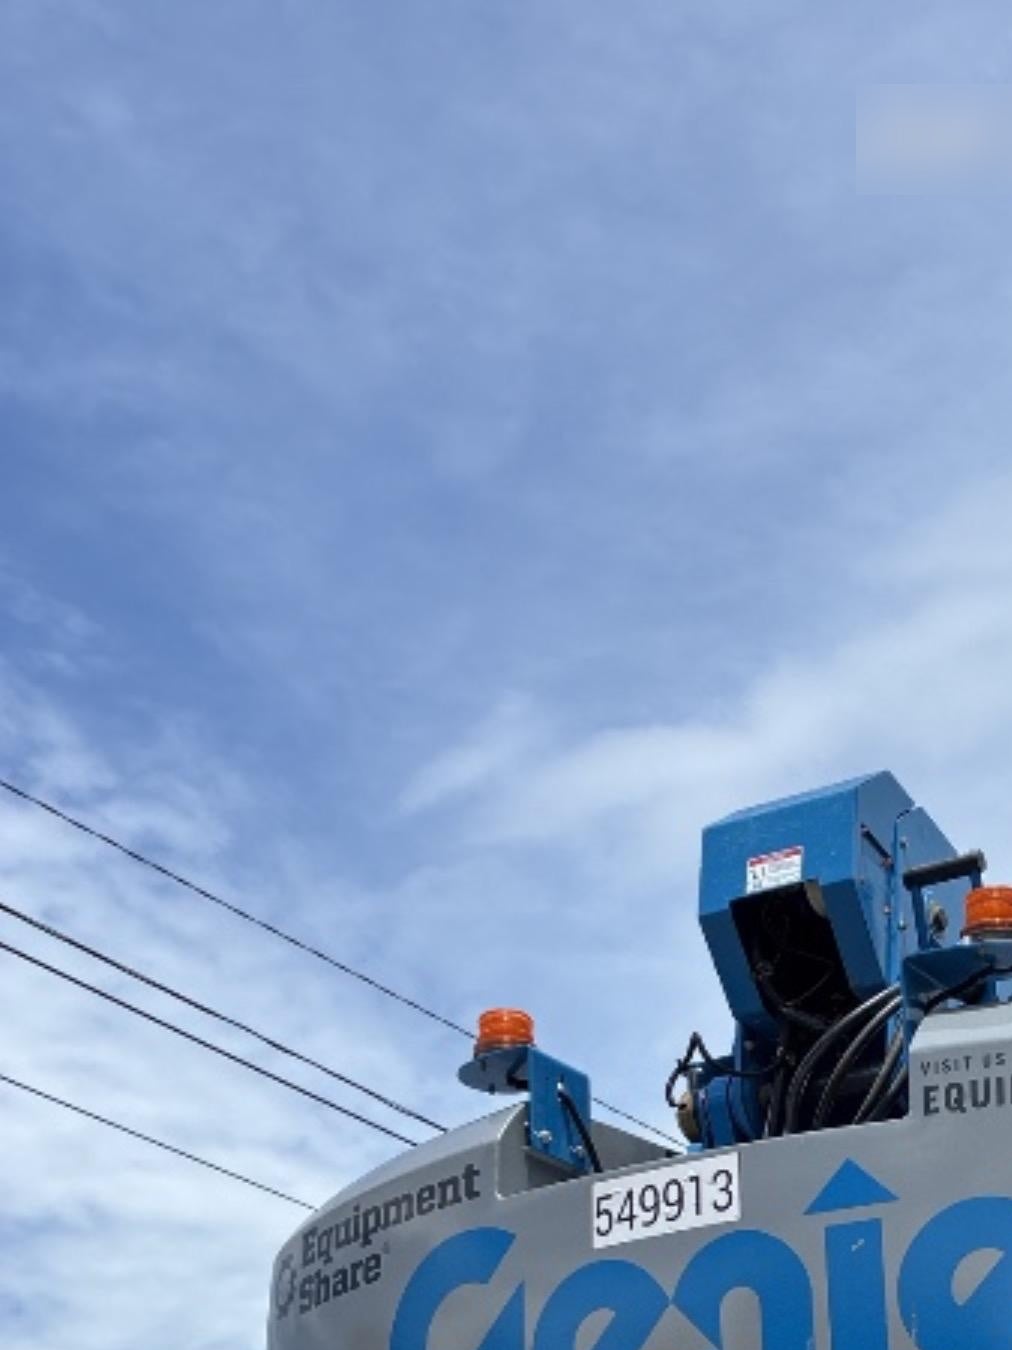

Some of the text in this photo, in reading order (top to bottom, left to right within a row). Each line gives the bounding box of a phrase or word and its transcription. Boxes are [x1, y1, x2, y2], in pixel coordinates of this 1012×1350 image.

[920, 1055, 972, 1077] VISIT
[983, 1052, 1006, 1069] US
[302, 1163, 481, 1266] Equipment
[595, 1169, 733, 1236] 549913
[300, 1252, 382, 1315] Share
